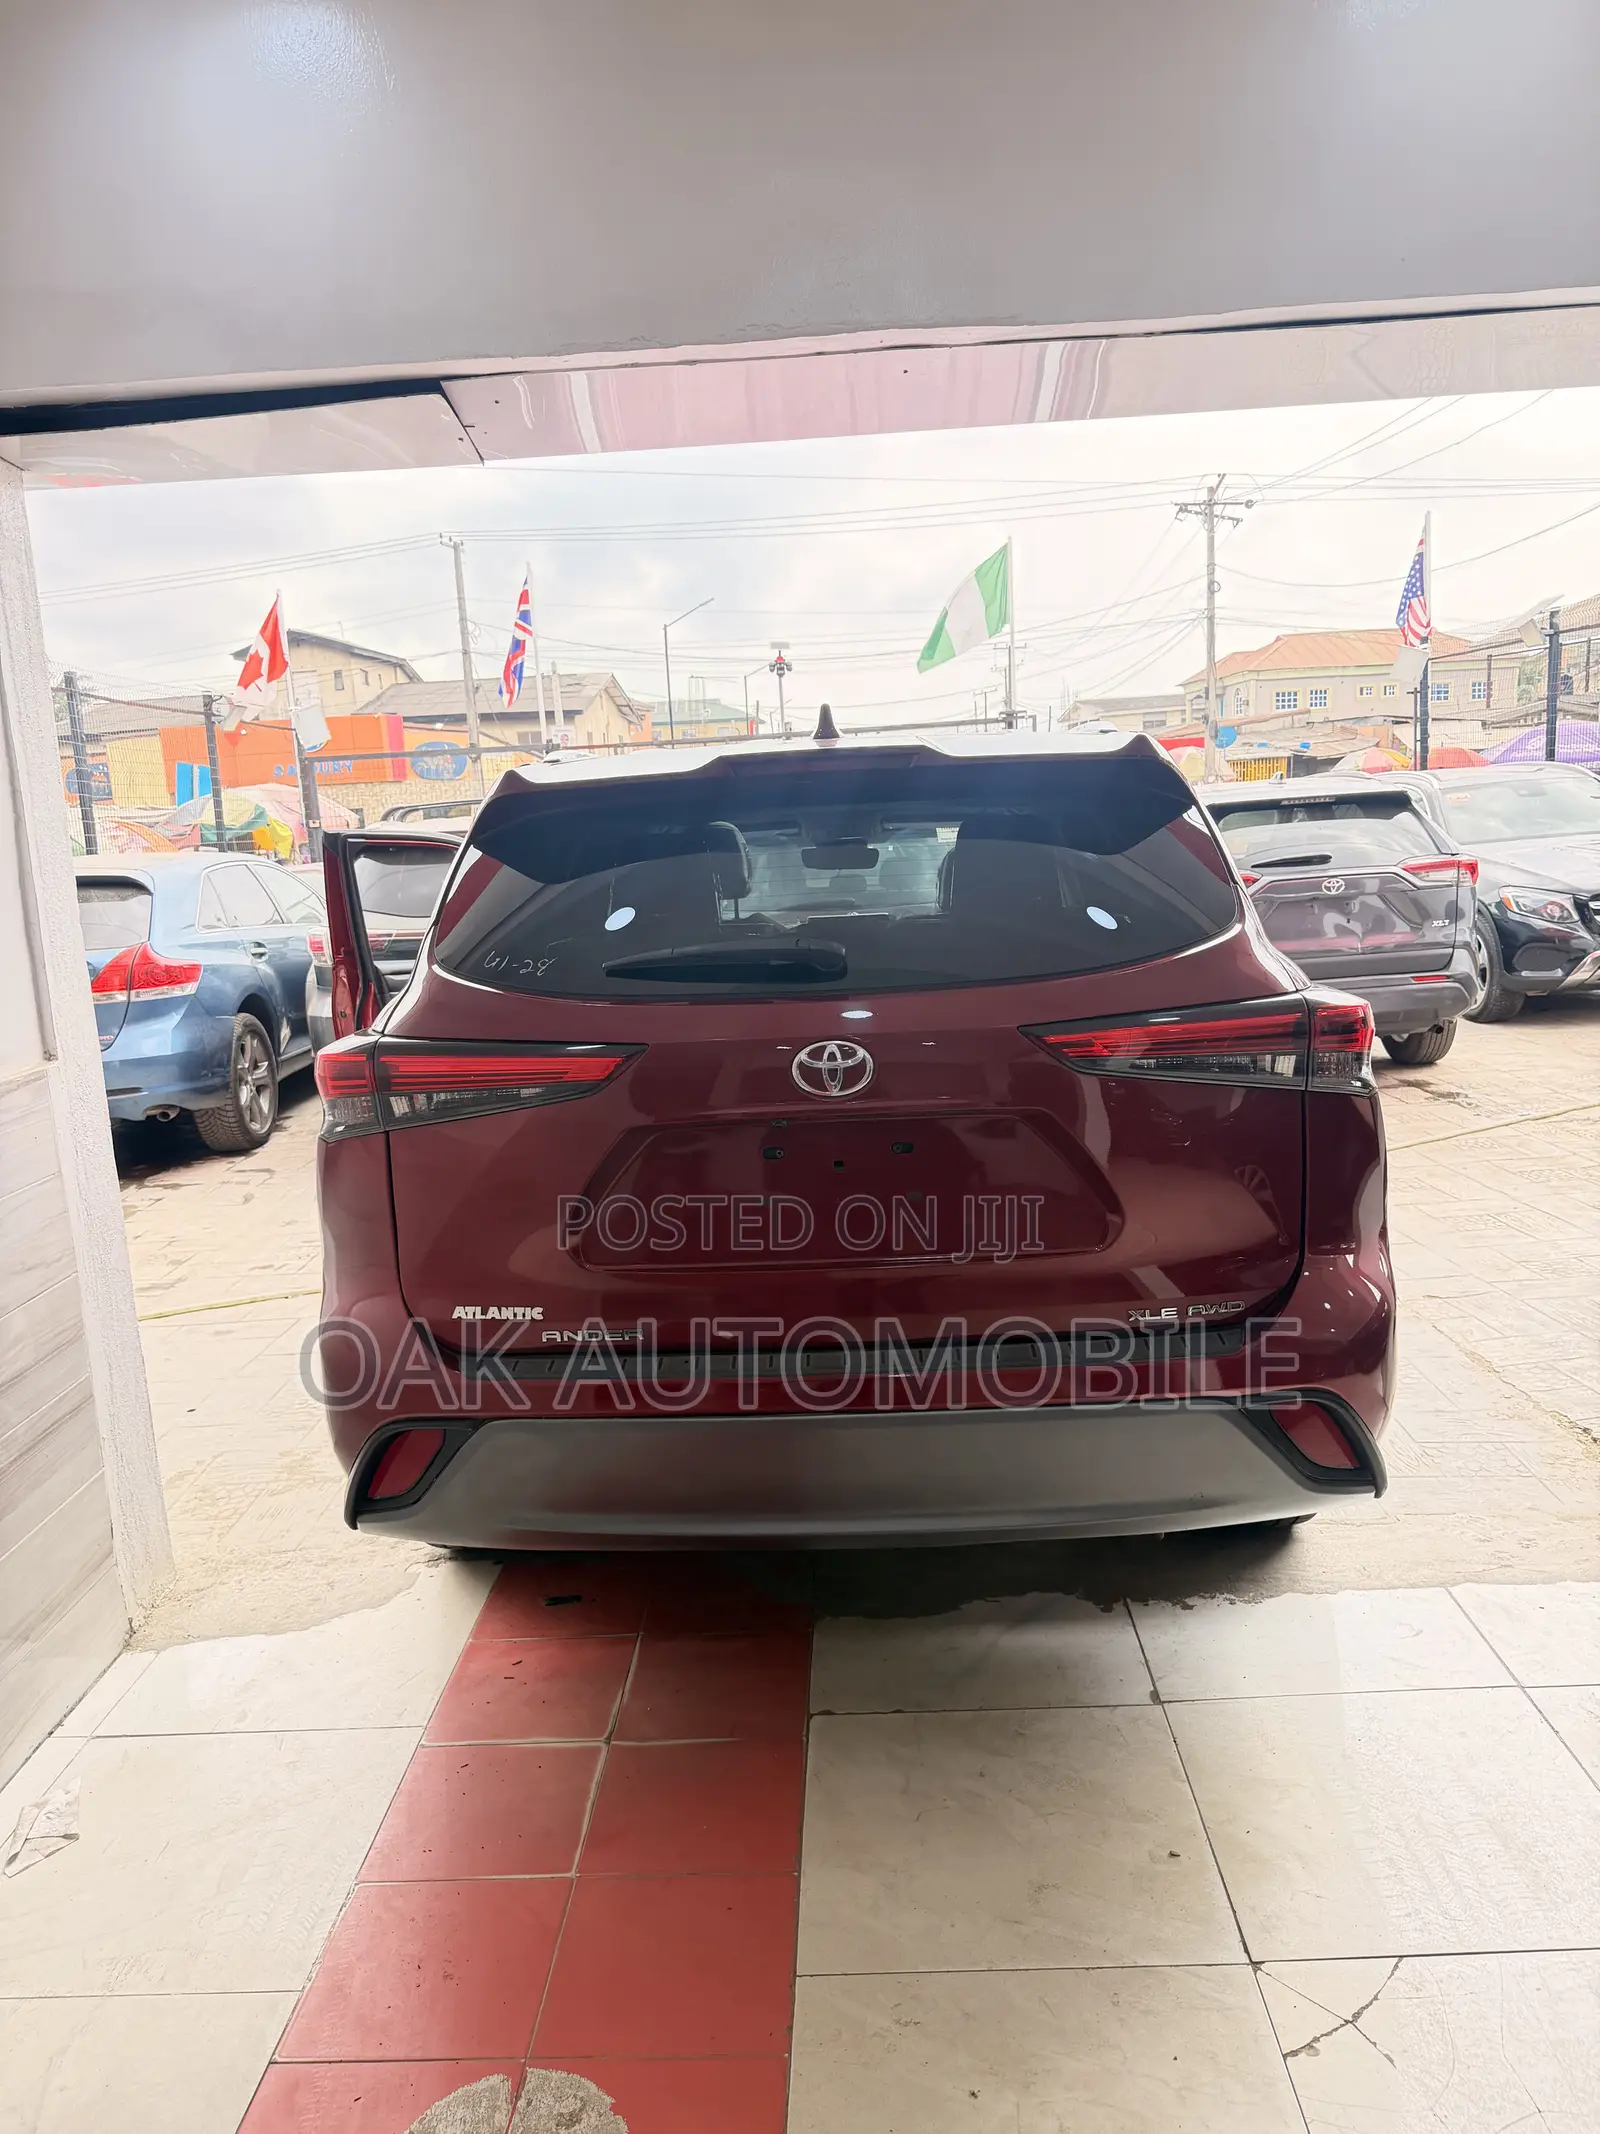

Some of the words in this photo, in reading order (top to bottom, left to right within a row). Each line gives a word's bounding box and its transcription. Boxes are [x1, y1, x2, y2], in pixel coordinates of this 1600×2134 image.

[451, 1305, 544, 1321] ATLANTIC
[1128, 1307, 1179, 1322] XLE
[1187, 1300, 1245, 1317] AWD
[541, 1328, 645, 1343] ANDER
